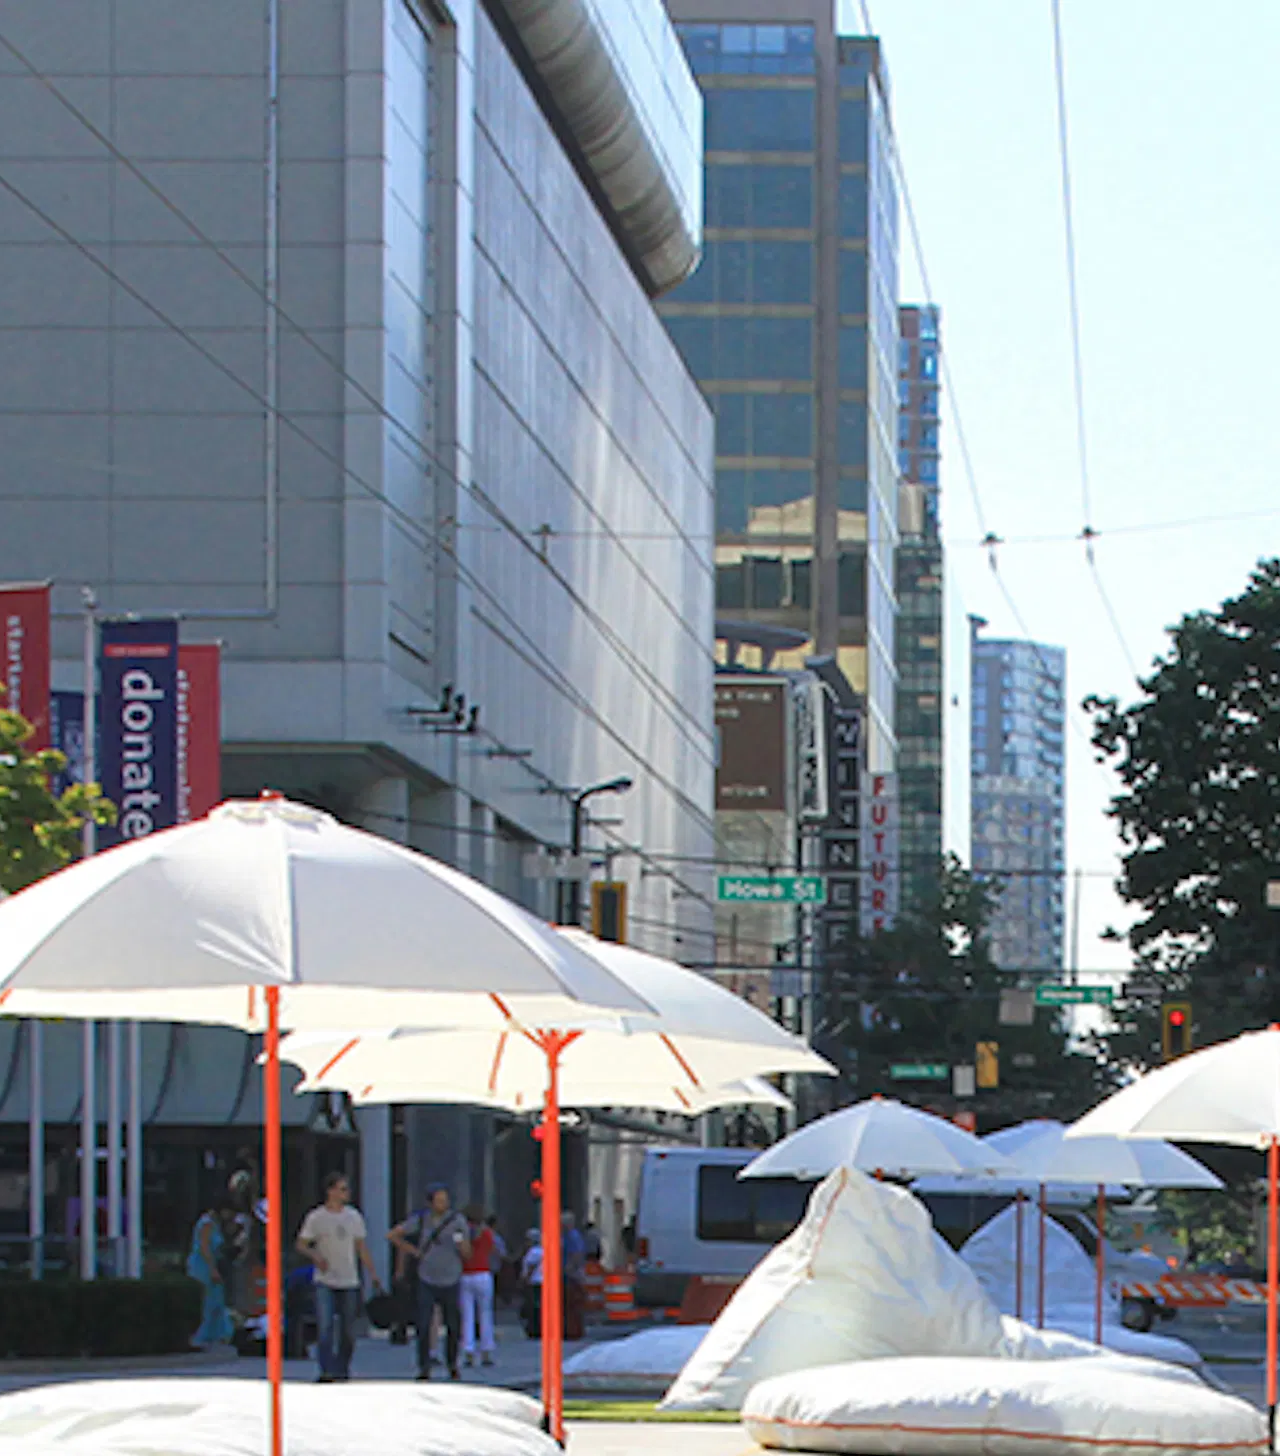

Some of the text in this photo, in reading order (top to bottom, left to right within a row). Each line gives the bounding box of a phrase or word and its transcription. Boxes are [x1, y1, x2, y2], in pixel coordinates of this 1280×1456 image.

[121, 669, 165, 840] donate
[724, 879, 817, 898] Howe St
